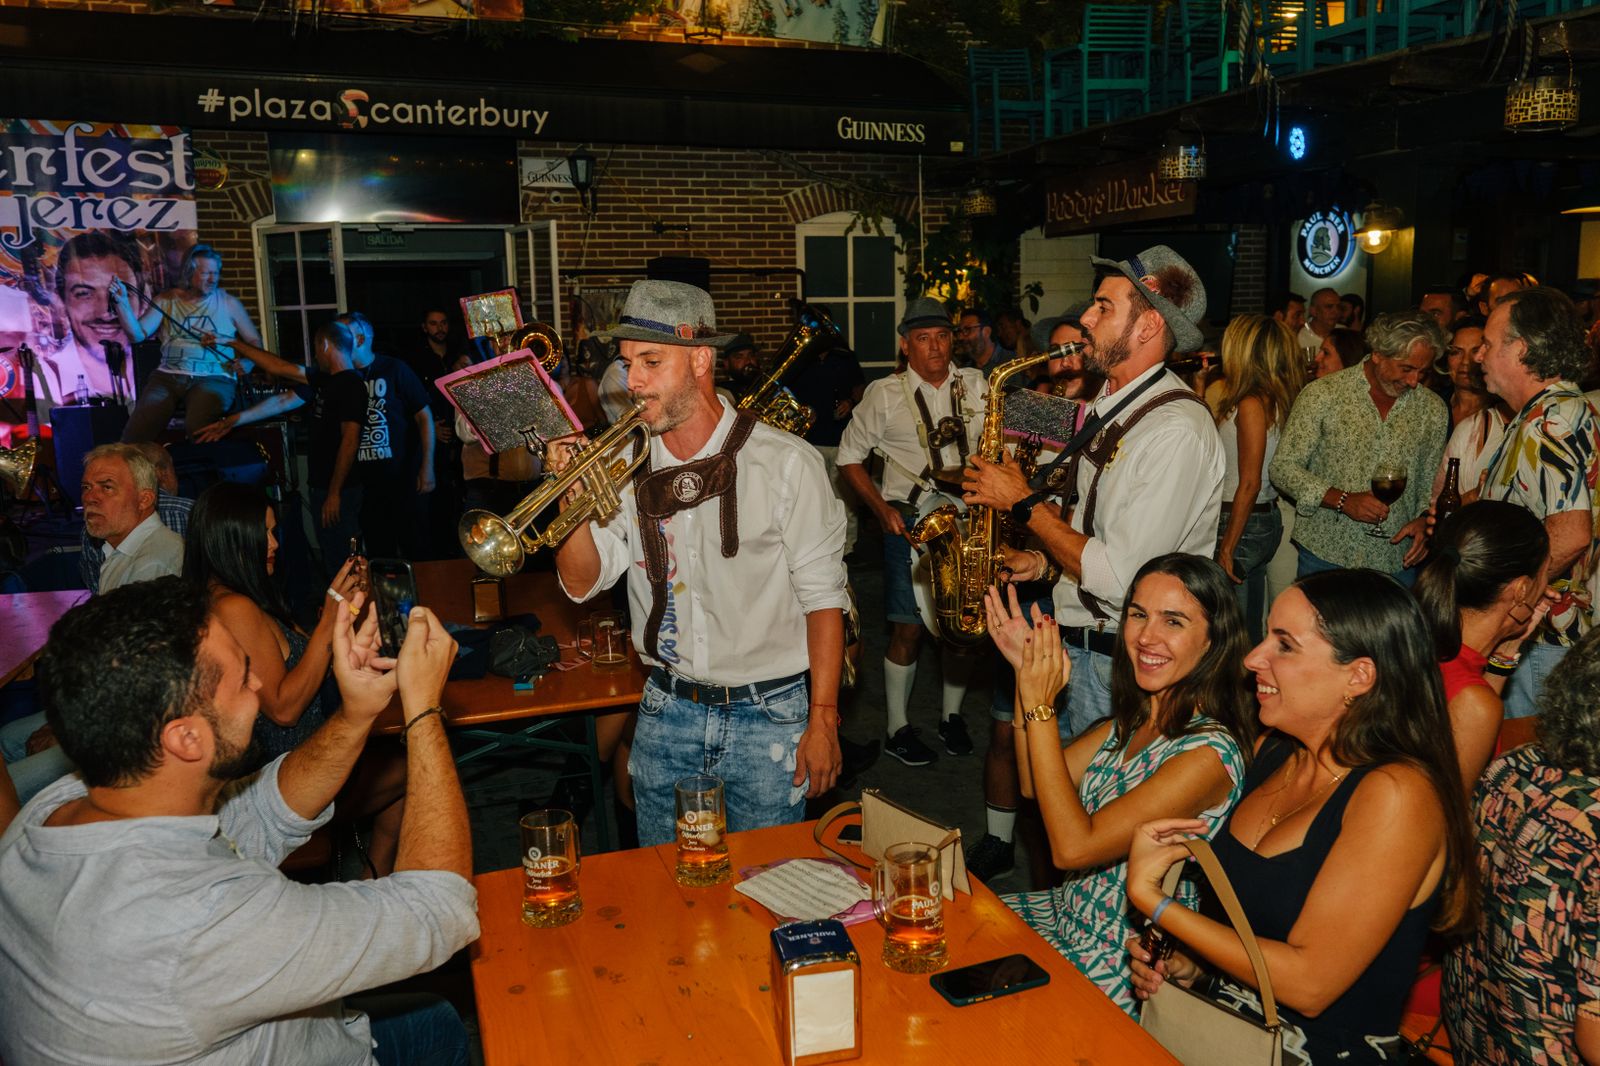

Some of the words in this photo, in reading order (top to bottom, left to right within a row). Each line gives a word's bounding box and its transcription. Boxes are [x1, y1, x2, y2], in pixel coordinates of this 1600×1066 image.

[198, 88, 331, 122] #plaza
[371, 98, 549, 134] canterbury
[837, 116, 925, 143] GUINNESS
[0, 122, 195, 190] rfest
[1300, 211, 1345, 237] PAULNER
